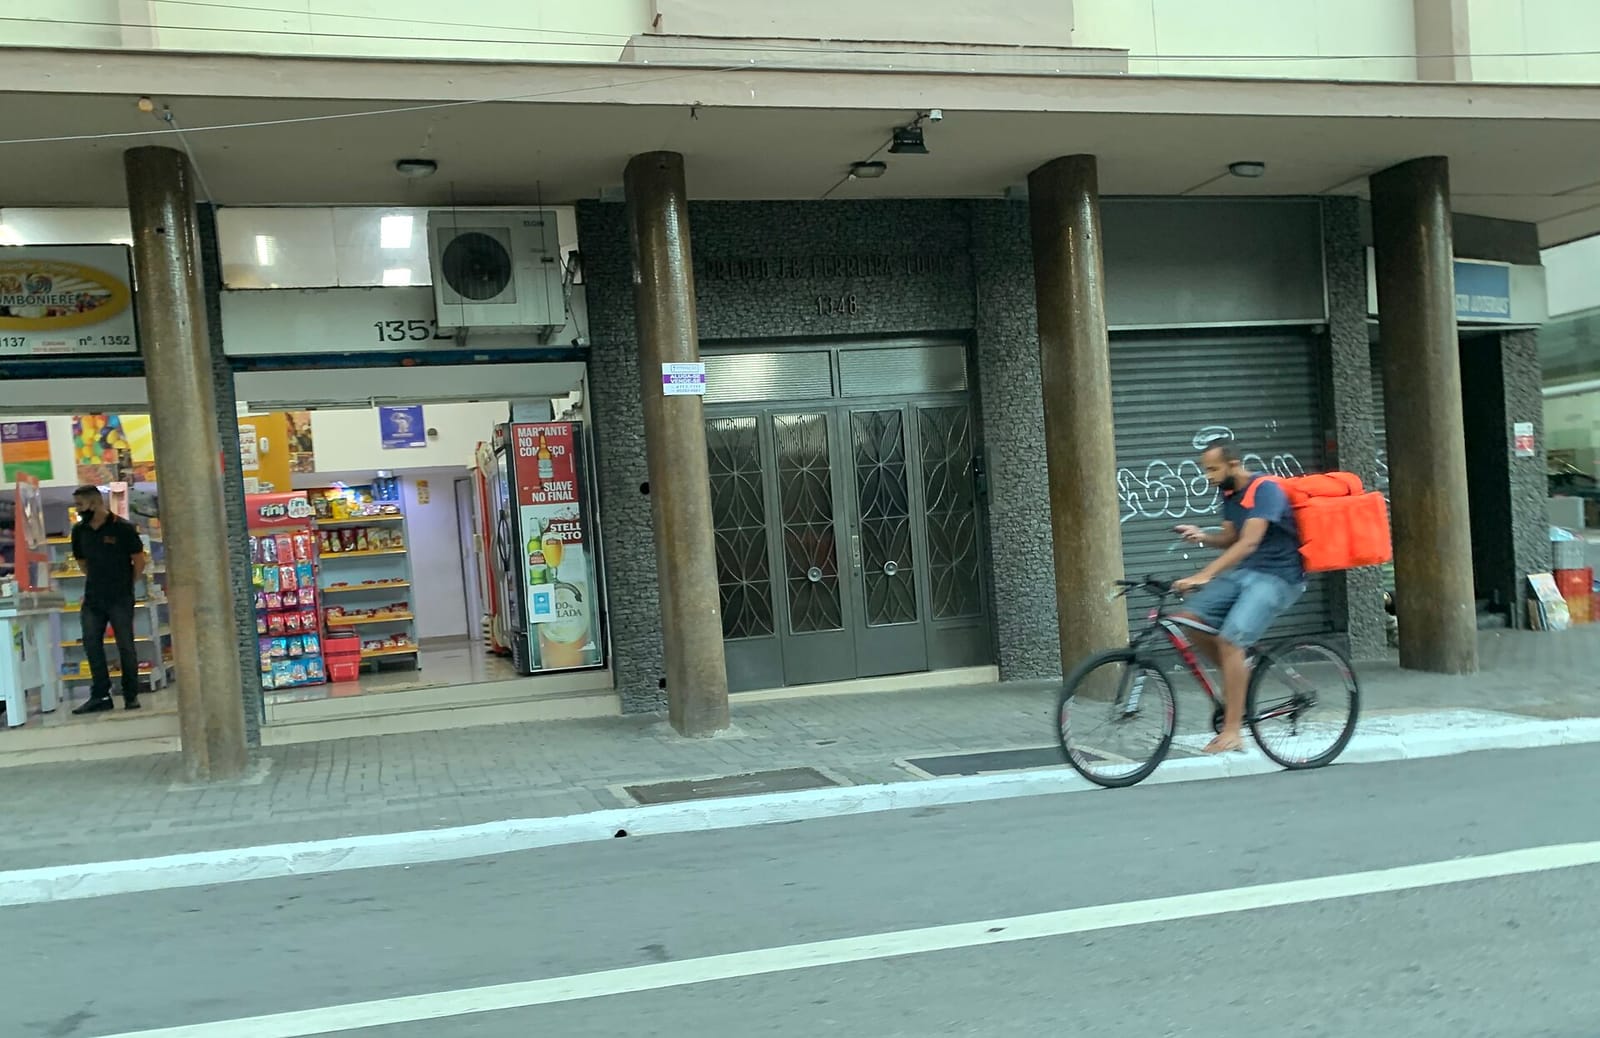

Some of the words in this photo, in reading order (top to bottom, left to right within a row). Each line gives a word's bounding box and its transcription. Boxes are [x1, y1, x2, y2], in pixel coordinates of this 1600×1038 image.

[0, 295, 75, 305] MBONIERE
[101, 335, 130, 346] 1352
[519, 437, 533, 448] NO
[543, 480, 574, 492] SUAVE
[532, 492, 546, 503] NO
[548, 491, 575, 502] FINAL
